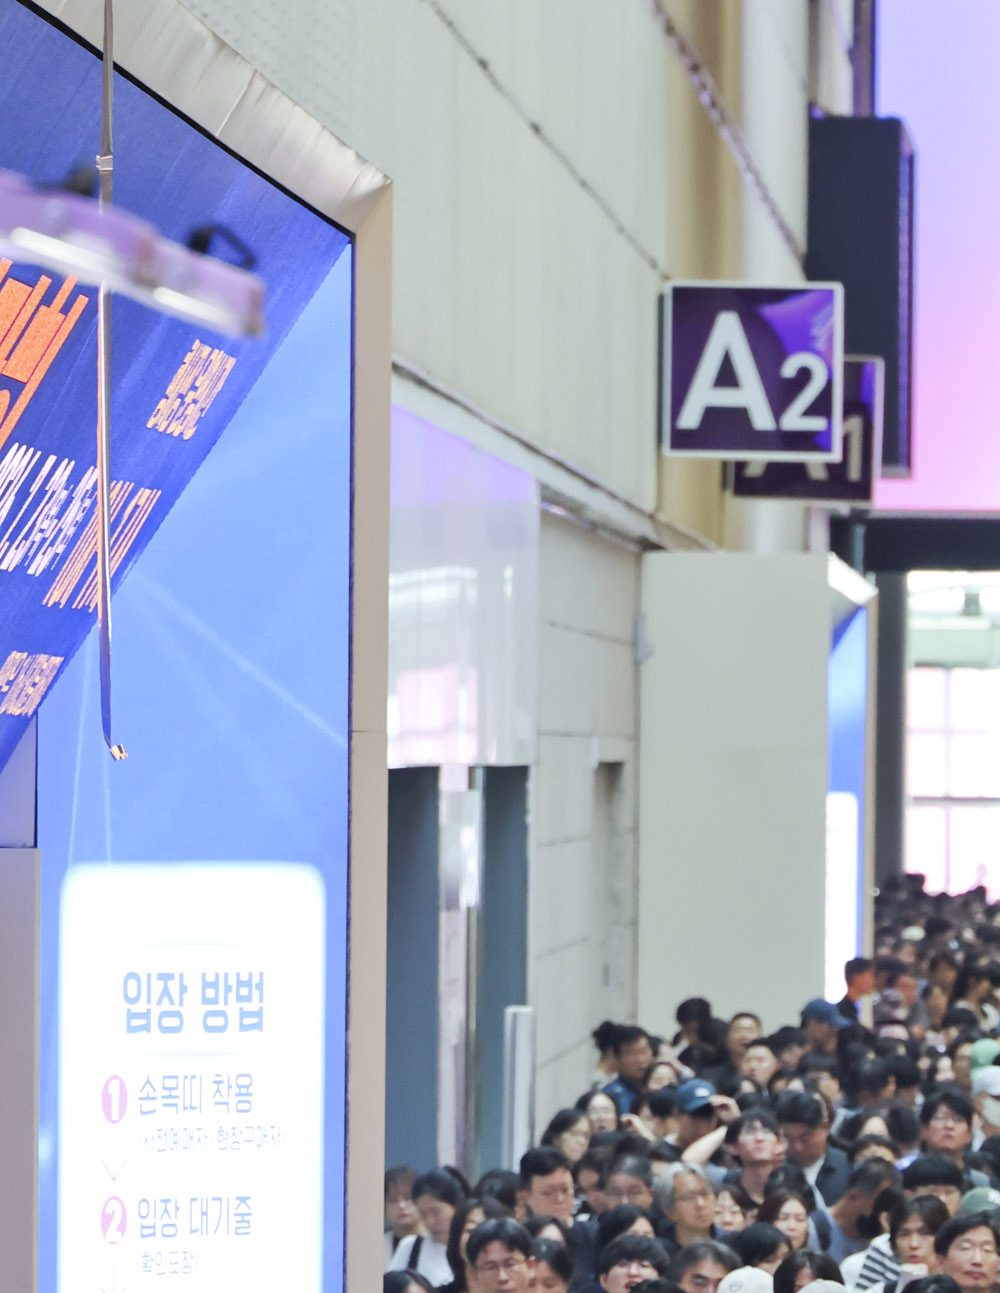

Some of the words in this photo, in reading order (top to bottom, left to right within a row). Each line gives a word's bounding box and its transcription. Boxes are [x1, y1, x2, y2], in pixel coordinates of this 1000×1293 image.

[675, 310, 828, 431] A2
[123, 972, 188, 1034] 입장
[201, 972, 264, 1033] 방법
[138, 1074, 202, 1115] 손목띠
[212, 1074, 253, 1113] 착용
[138, 1198, 180, 1239] 입장
[189, 1196, 252, 1237] 대기줄
